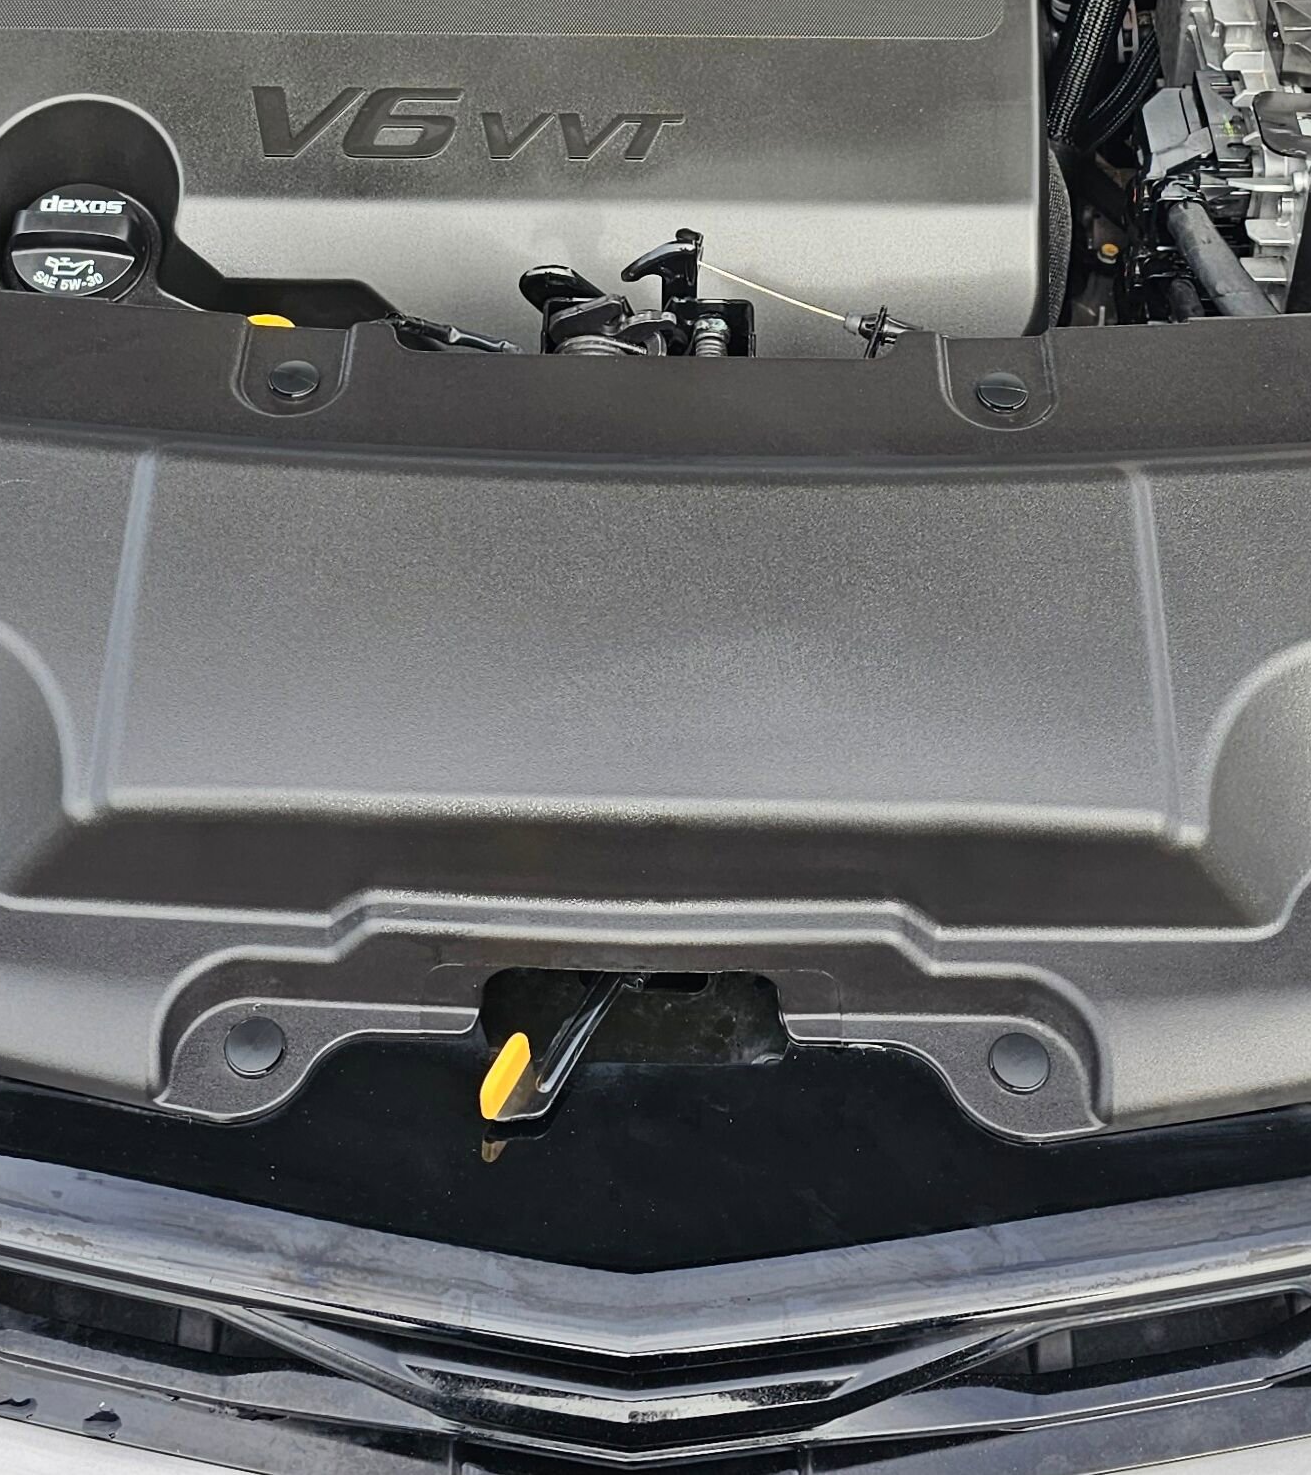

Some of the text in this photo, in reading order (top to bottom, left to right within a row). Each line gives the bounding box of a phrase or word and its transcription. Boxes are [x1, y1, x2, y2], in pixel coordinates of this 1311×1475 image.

[252, 86, 685, 161] V6 VVT
[40, 195, 126, 214] dexos
[33, 271, 103, 291] SAE 5W-30
